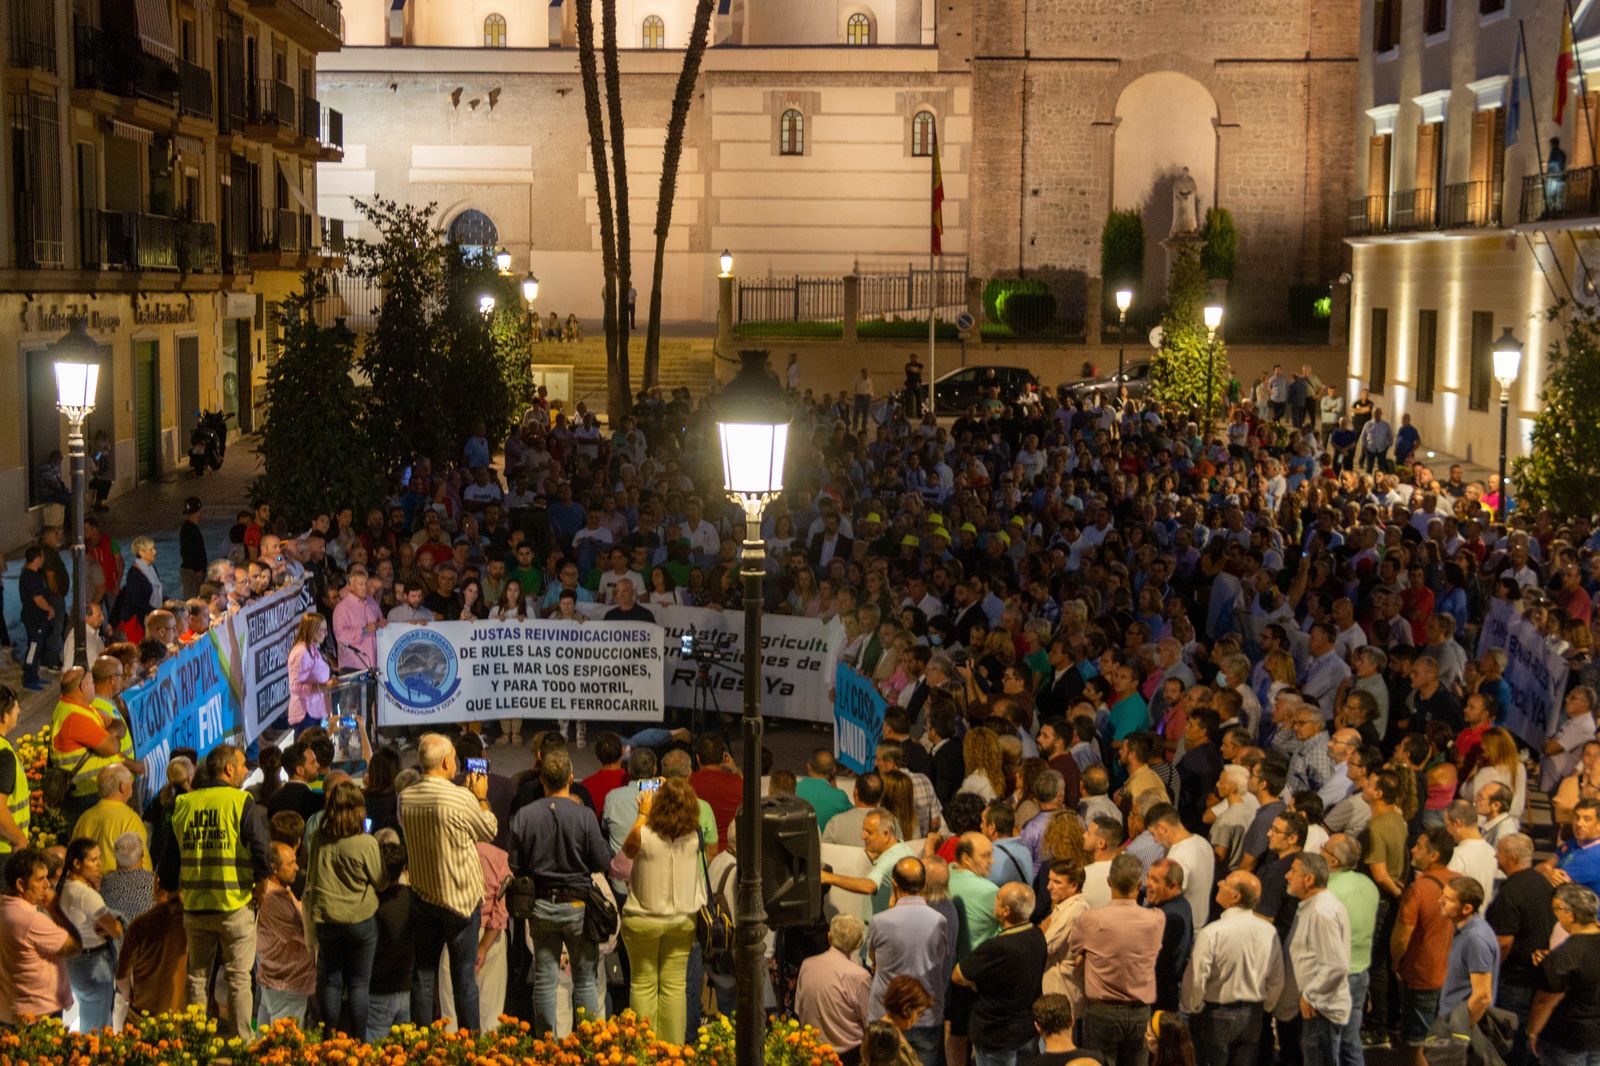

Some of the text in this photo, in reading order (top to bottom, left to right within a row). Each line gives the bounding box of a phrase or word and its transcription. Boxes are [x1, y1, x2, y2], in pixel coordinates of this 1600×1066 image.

[470, 627, 650, 642] JUSTAS REIVINDICACIONES:
[460, 645, 661, 662] DE RULES LAS CONDUCCIONES,
[472, 662, 651, 679] EN EL MAR LOS ESPIGONES,
[796, 656, 821, 671] de
[491, 680, 633, 696] Y PARA TODO MOTRIL,
[671, 668, 795, 696] Rles Ya
[466, 696, 660, 712] QUE LLEGUE EL FERROCARRIL
